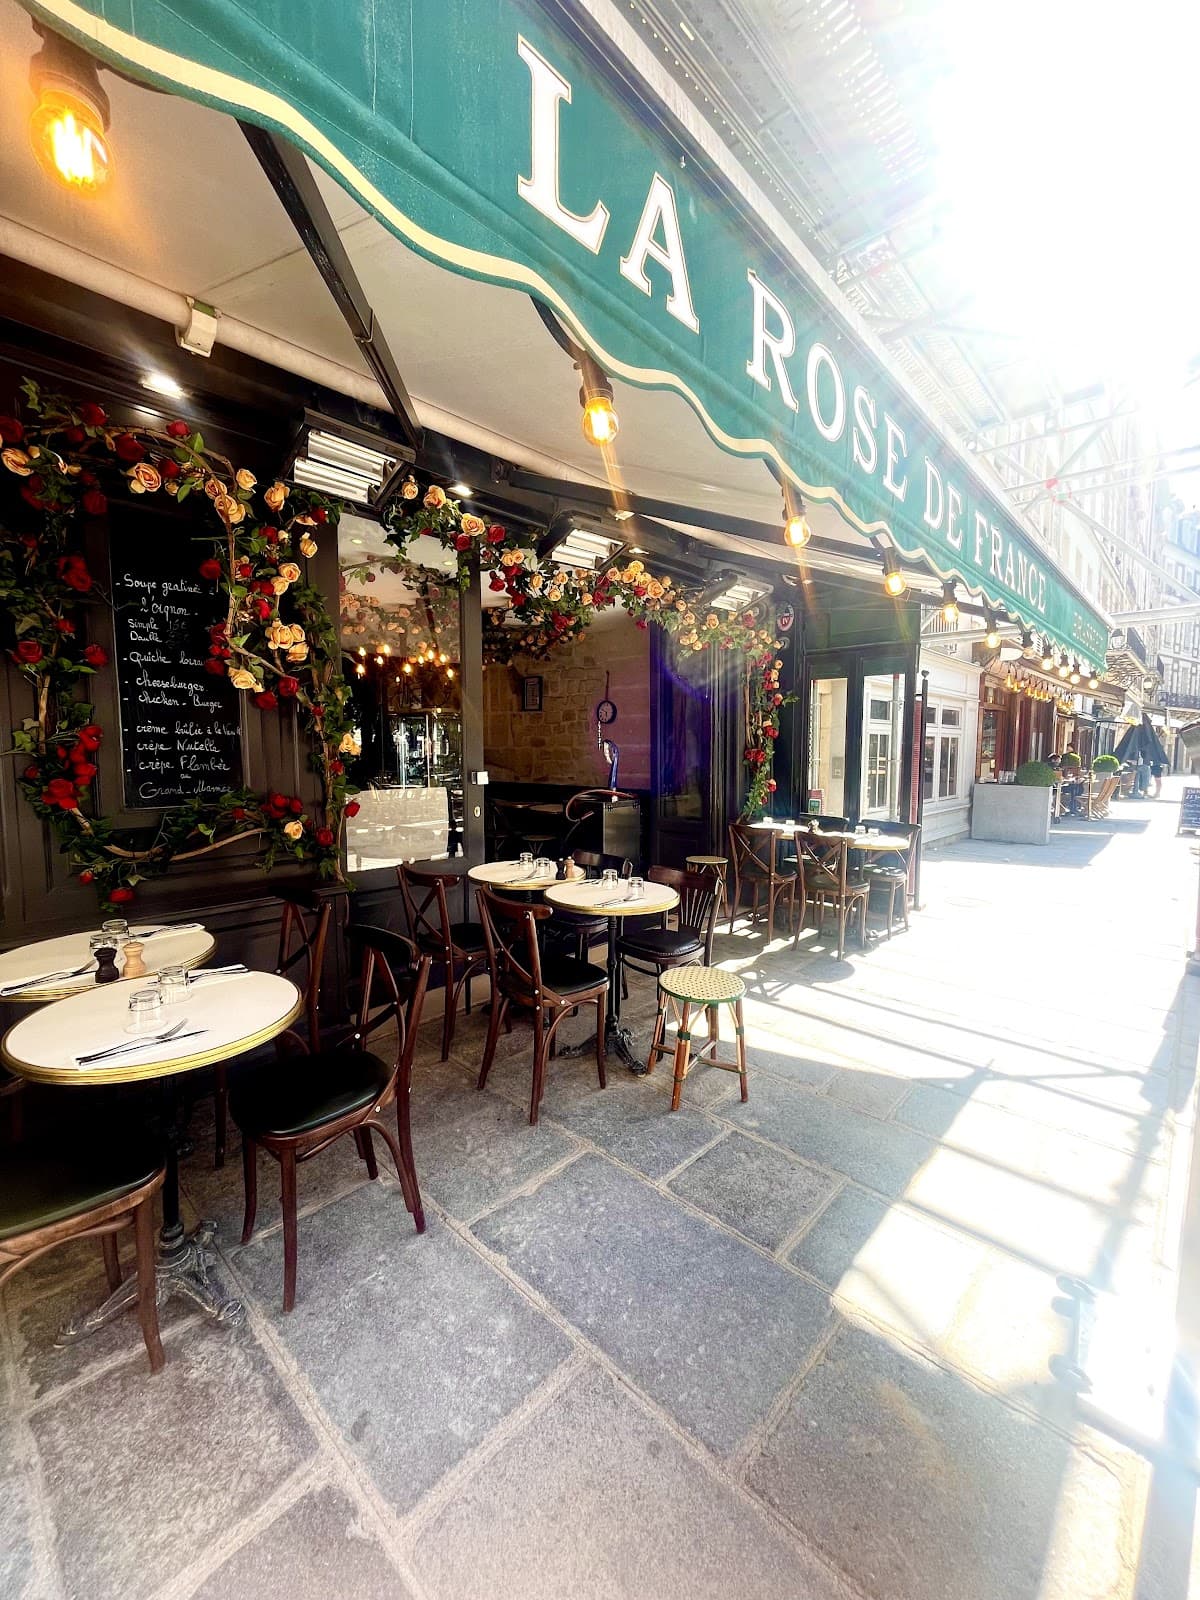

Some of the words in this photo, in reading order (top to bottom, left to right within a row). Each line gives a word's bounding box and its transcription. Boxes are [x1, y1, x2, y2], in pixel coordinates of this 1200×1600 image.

[518, 32, 699, 334] LA
[746, 267, 907, 501] ROSE
[924, 456, 963, 551] DE
[974, 510, 1047, 613] FRANCE
[123, 573, 157, 595] Soupe
